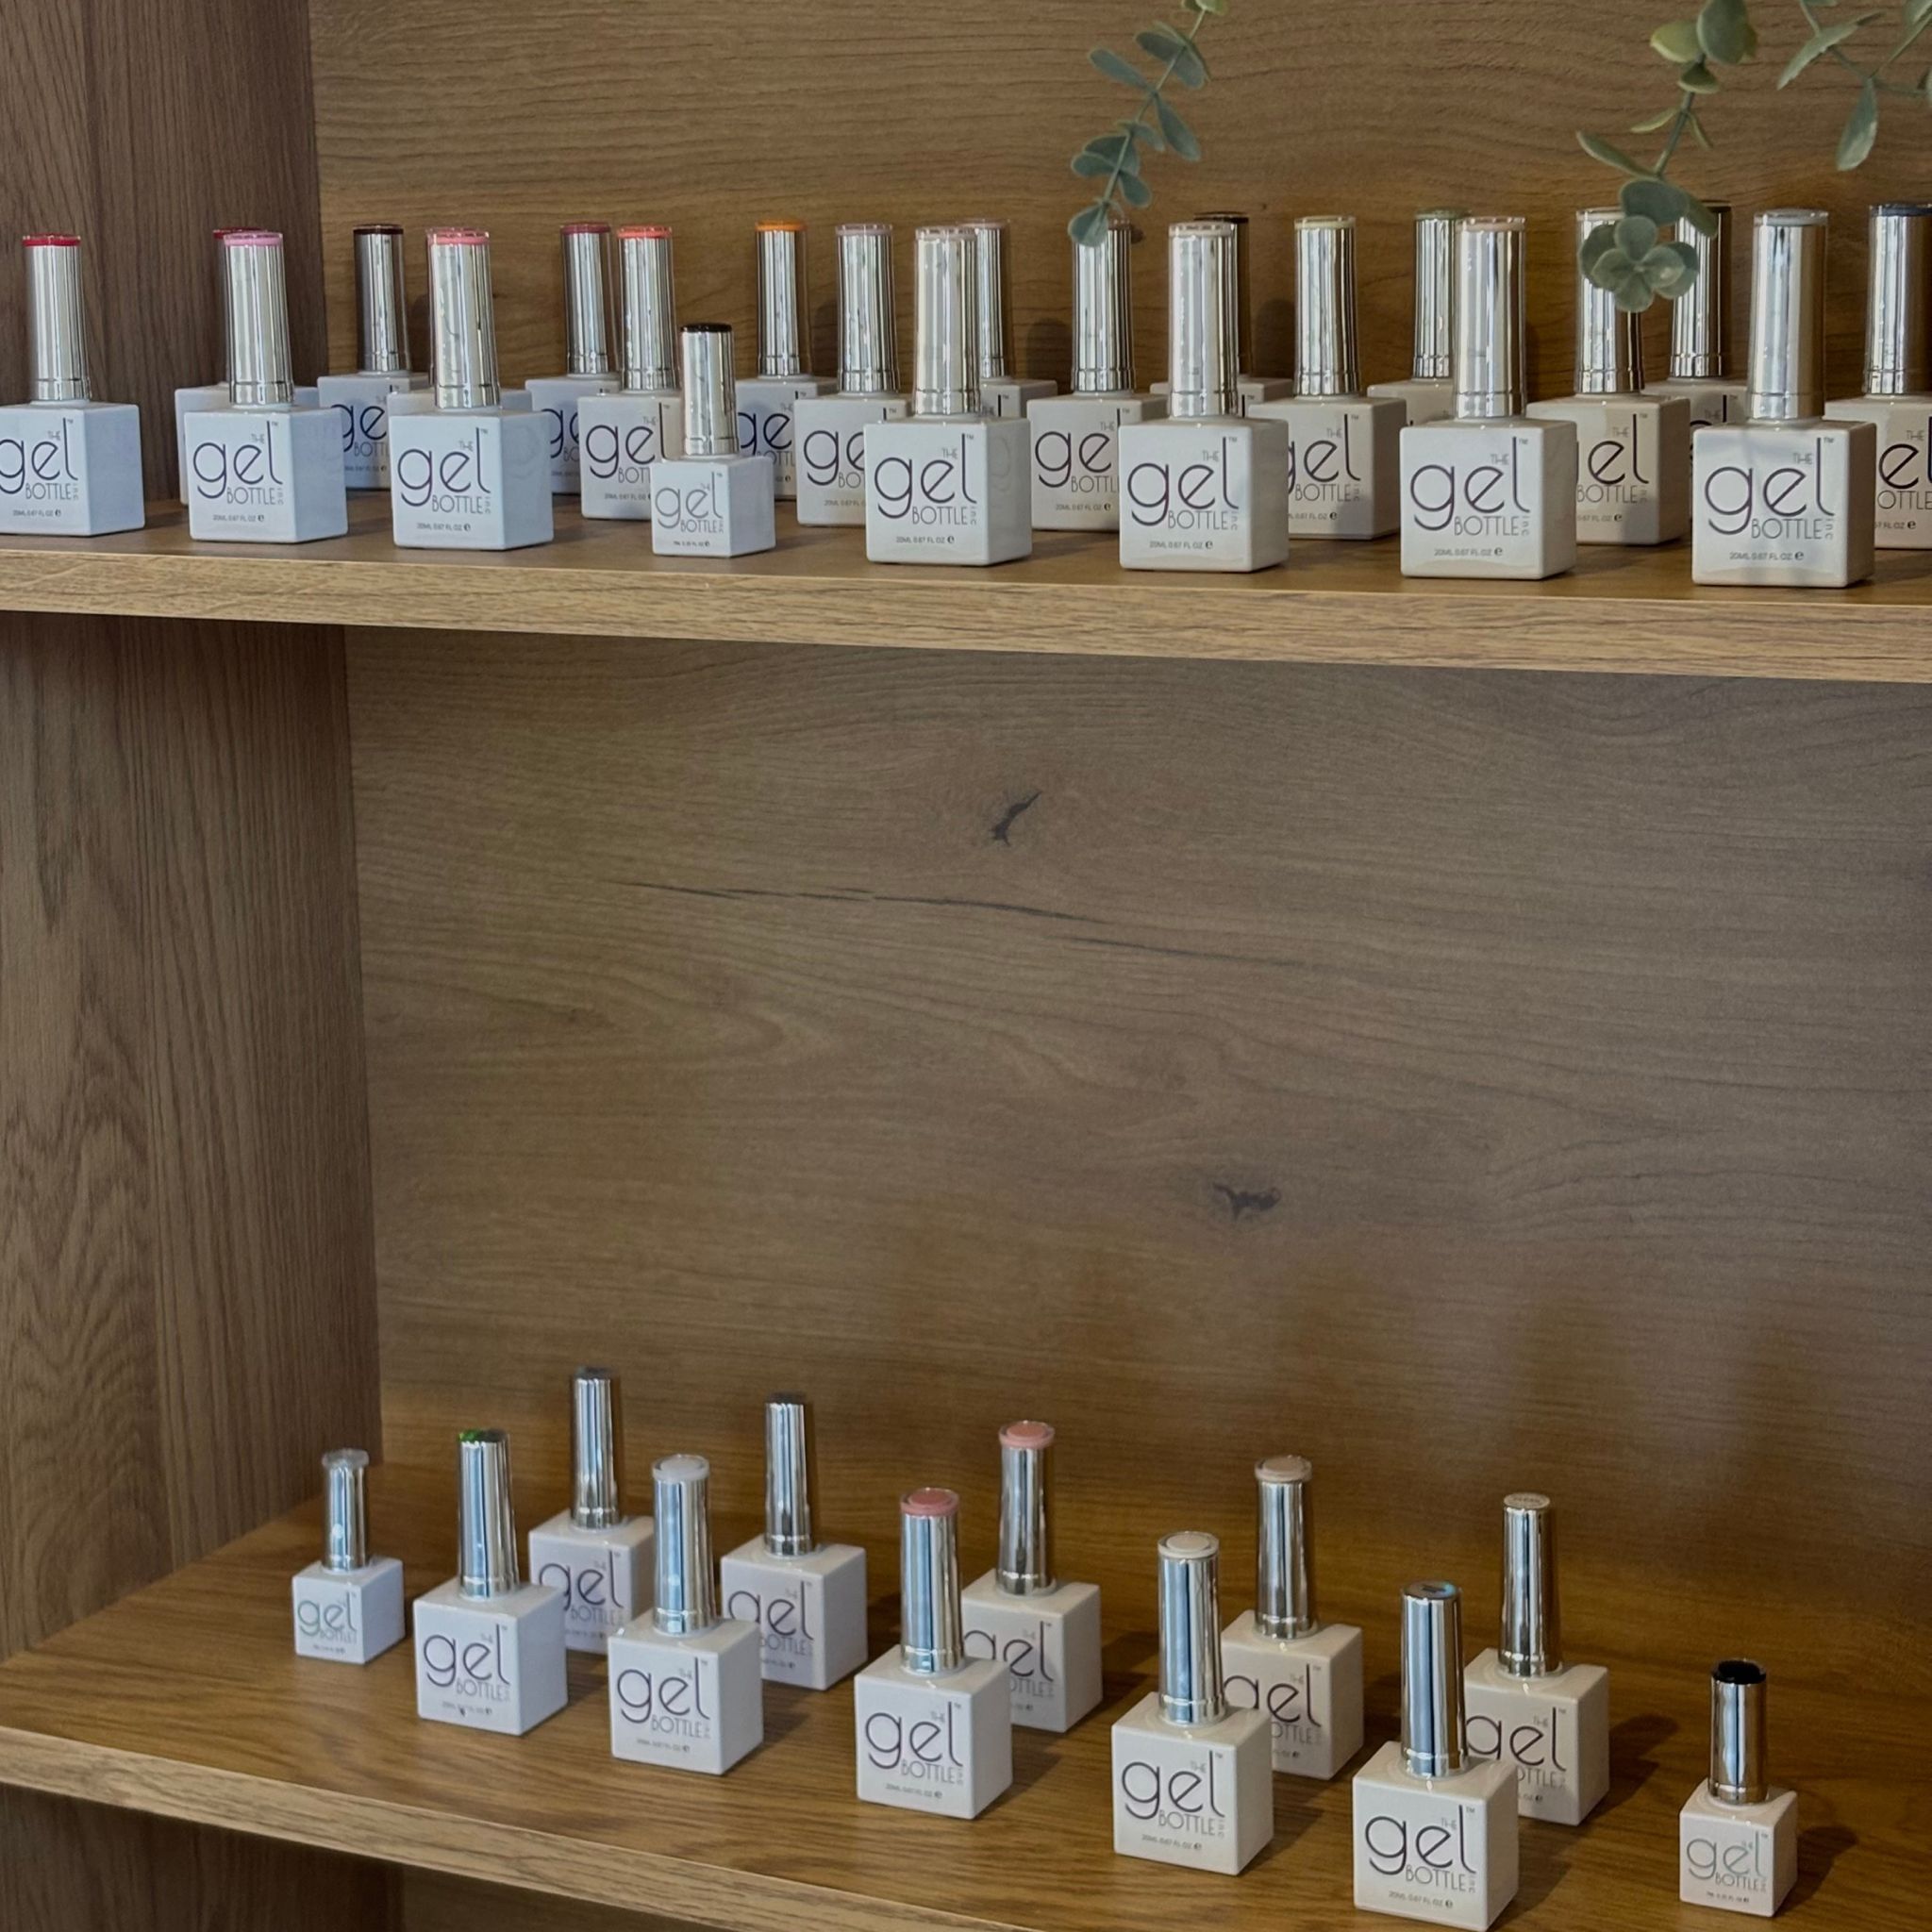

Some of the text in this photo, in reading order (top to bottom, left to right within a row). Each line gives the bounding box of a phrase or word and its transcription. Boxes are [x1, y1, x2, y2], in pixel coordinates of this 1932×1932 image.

[586, 402, 671, 479] gel
[1906, 430, 1924, 441] THE
[192, 421, 283, 499] gel
[397, 426, 491, 507] gel
[1202, 450, 1220, 461] THE
[1490, 453, 1509, 465] THE
[1793, 453, 1813, 465] THE
[618, 466, 651, 484] BOTT
[874, 433, 977, 519] gel
[1071, 475, 1117, 493] BOTTL
[1127, 437, 1239, 525] gel
[1410, 436, 1531, 531] gel
[1705, 437, 1835, 535] gel
[25, 482, 71, 500] BOTTLE
[226, 487, 275, 506] BOTTLE
[655, 472, 724, 528] gel
[1294, 483, 1352, 502] BOTTLE
[1576, 484, 1639, 504] BOTTLE
[1877, 490, 1932, 509] OTTLE
[432, 494, 483, 514] BOTTLE
[912, 506, 968, 525] BOTTLE
[680, 519, 717, 534] BOTTLE
[1168, 509, 1229, 530] BOTTLE
[1454, 516, 1520, 536] BOTTLE
[1751, 518, 1823, 540] BOTTLE
[297, 1591, 358, 1637] gel
[424, 1624, 510, 1688] gel
[456, 1678, 504, 1702] BOTTLE
[617, 1657, 710, 1724] gel
[651, 1714, 703, 1739] BOTTLE
[865, 1701, 963, 1769] gel
[901, 1758, 956, 1785] BOTTLE
[1122, 1750, 1225, 1820] gel
[1158, 1809, 1216, 1837] BOTTLE
[1365, 1805, 1476, 1875] gel
[1687, 1831, 1767, 1882] gel
[1405, 1864, 1467, 1892] BOTTLE
